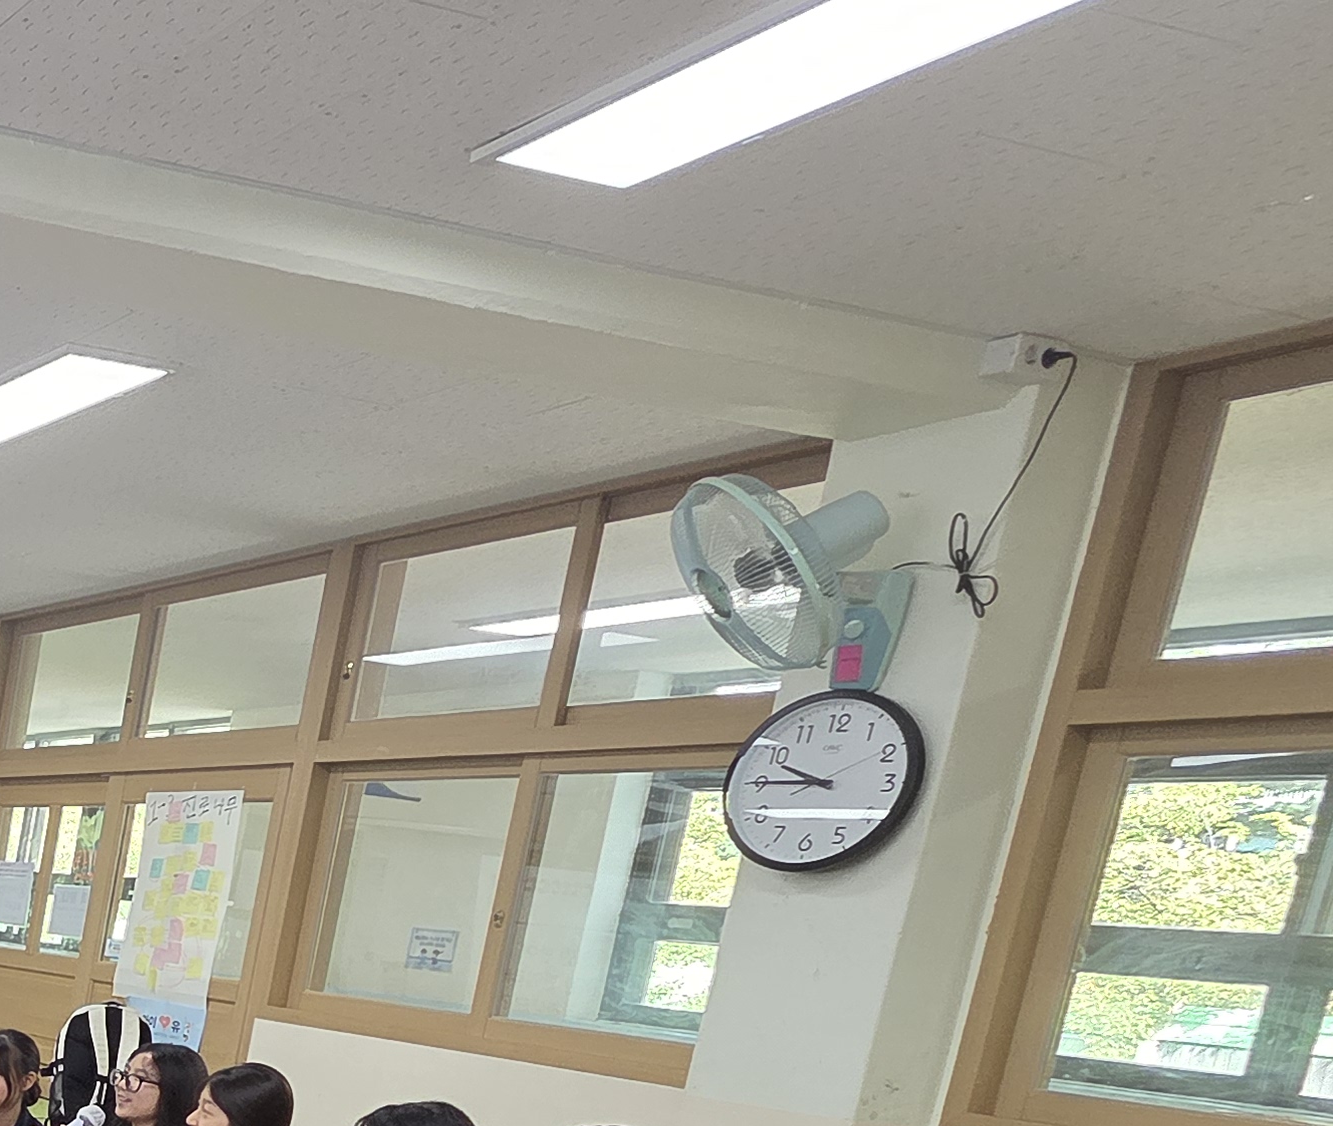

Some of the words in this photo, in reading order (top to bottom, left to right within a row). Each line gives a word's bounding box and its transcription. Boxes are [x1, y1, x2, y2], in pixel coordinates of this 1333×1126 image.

[828, 713, 852, 733] 12
[866, 722, 875, 742] 1
[796, 724, 814, 744] 11
[769, 746, 790, 765] 10
[879, 743, 897, 763] 2
[879, 773, 897, 792] 3
[773, 825, 786, 843] 7
[798, 833, 813, 851] 6
[831, 826, 847, 845] 5
